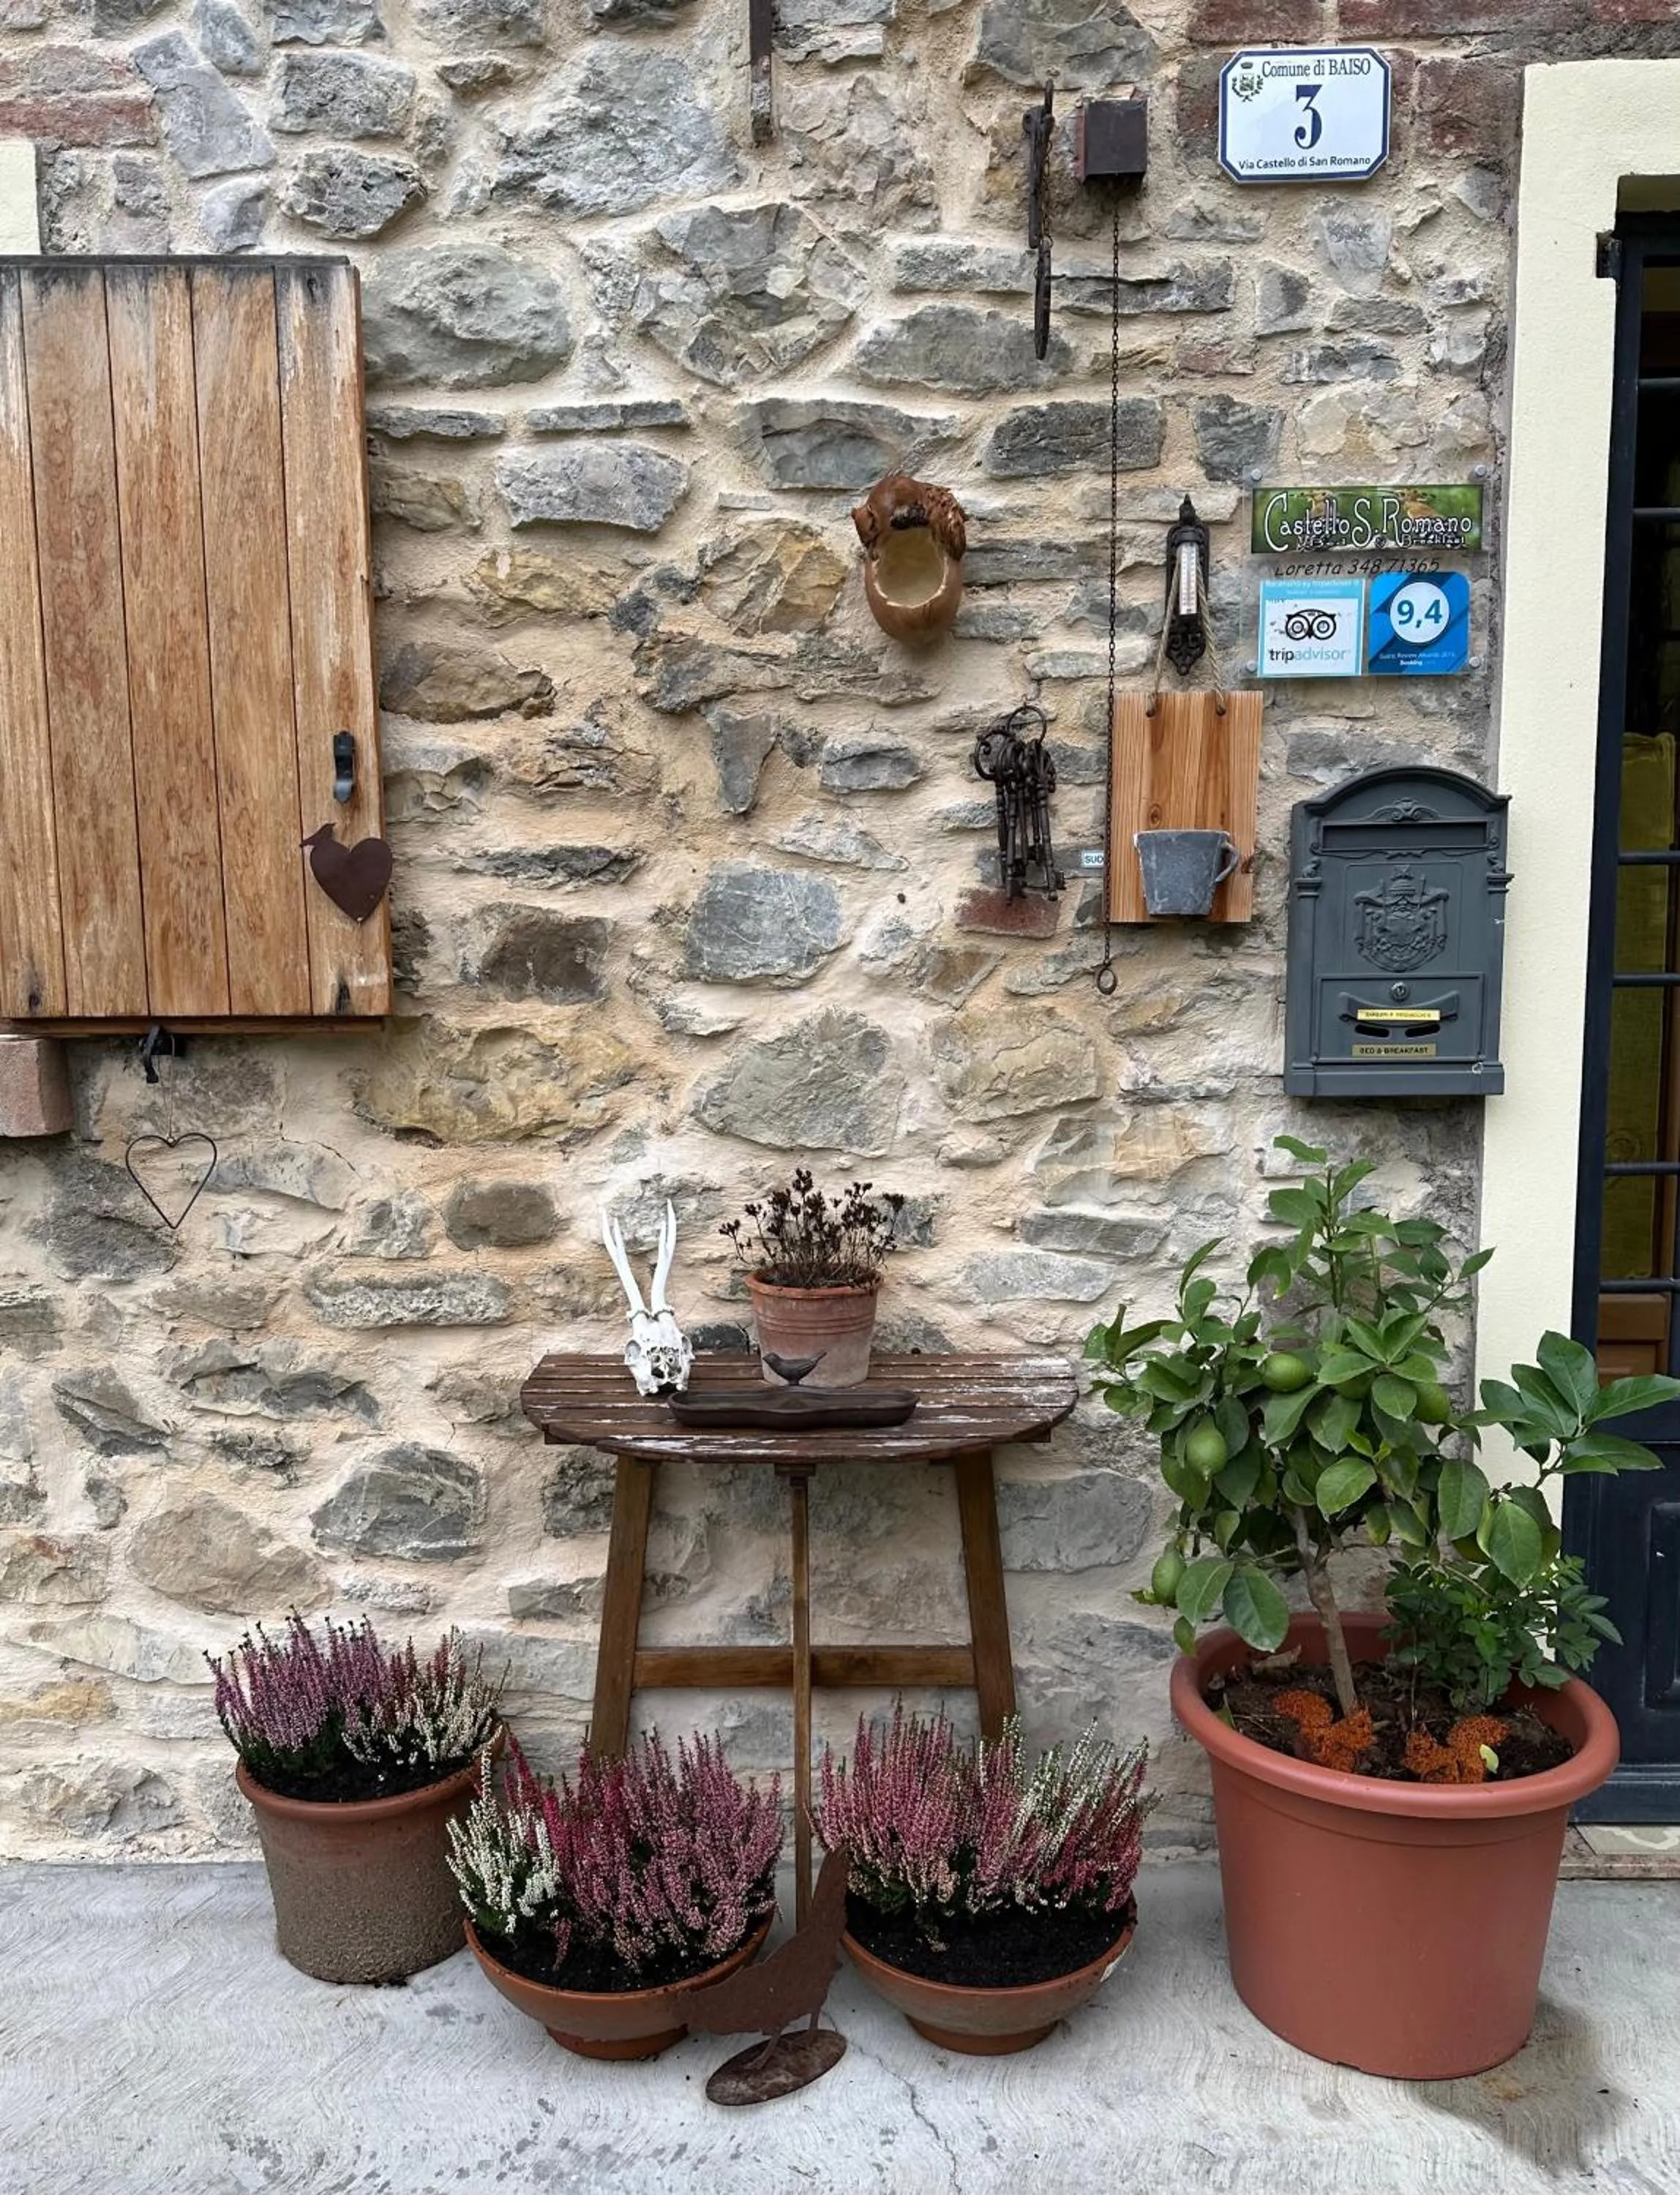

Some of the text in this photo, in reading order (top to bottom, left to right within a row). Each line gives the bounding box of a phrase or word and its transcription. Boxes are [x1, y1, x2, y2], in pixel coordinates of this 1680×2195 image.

[1262, 58, 1371, 78] Comune di BAISO
[1294, 84, 1323, 150] 3
[1239, 155, 1371, 170] Via Castello di San Romano
[1264, 491, 1350, 552] Castello
[1382, 498, 1472, 548] Romano
[1275, 561, 1342, 577] Loretta
[1397, 599, 1443, 628] 9,4
[1270, 647, 1347, 663] tripadvisor
